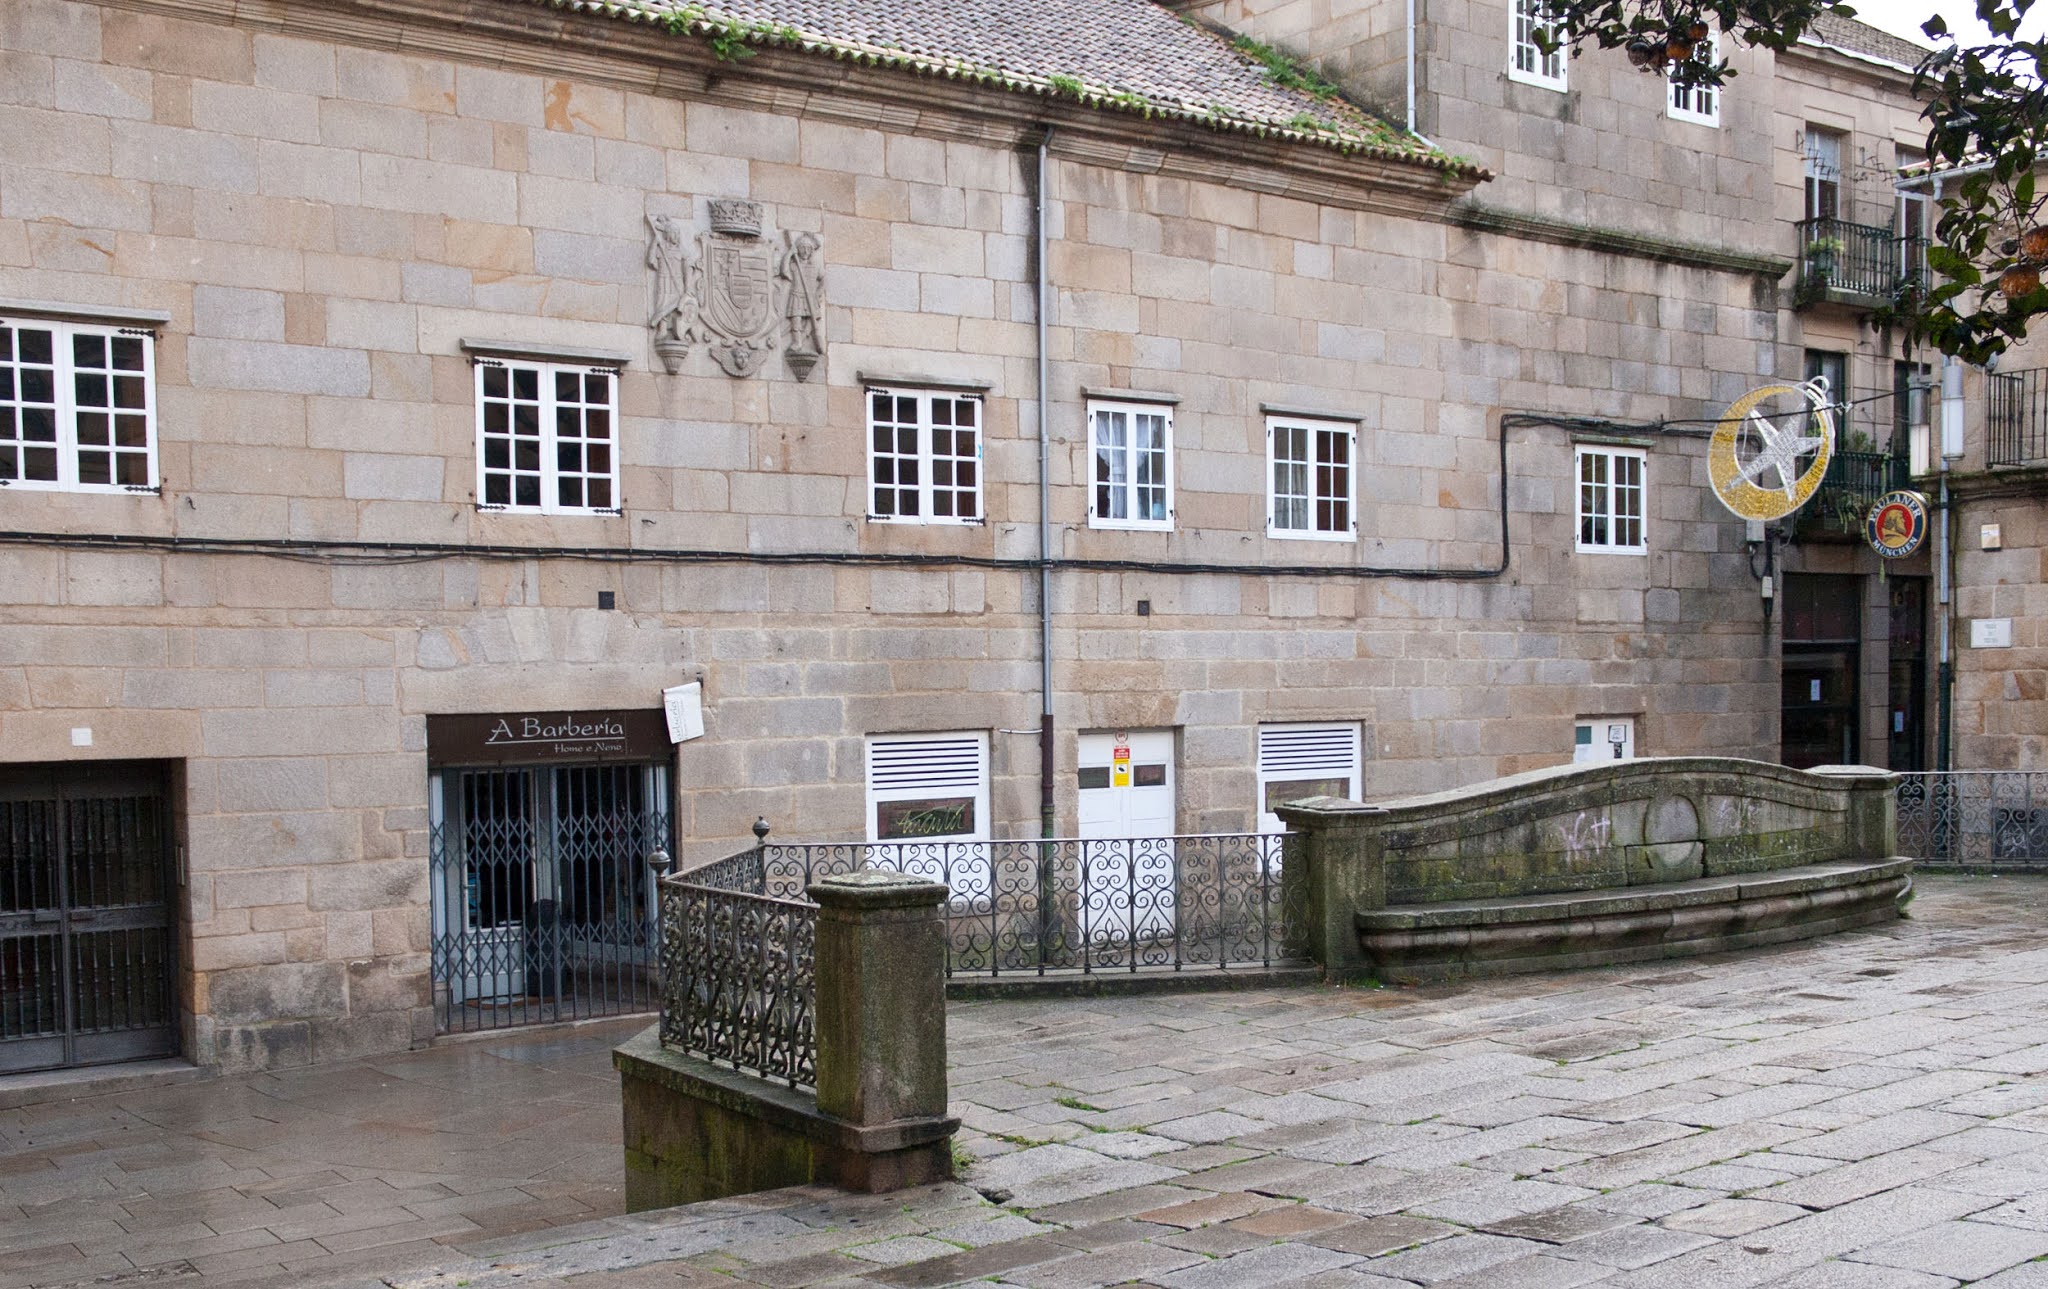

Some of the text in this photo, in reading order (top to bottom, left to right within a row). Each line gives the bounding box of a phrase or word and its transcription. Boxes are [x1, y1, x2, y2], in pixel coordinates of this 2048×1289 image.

[1868, 494, 1922, 523] PAULANER
[489, 716, 624, 741] A Barbería
[554, 743, 584, 753] Home
